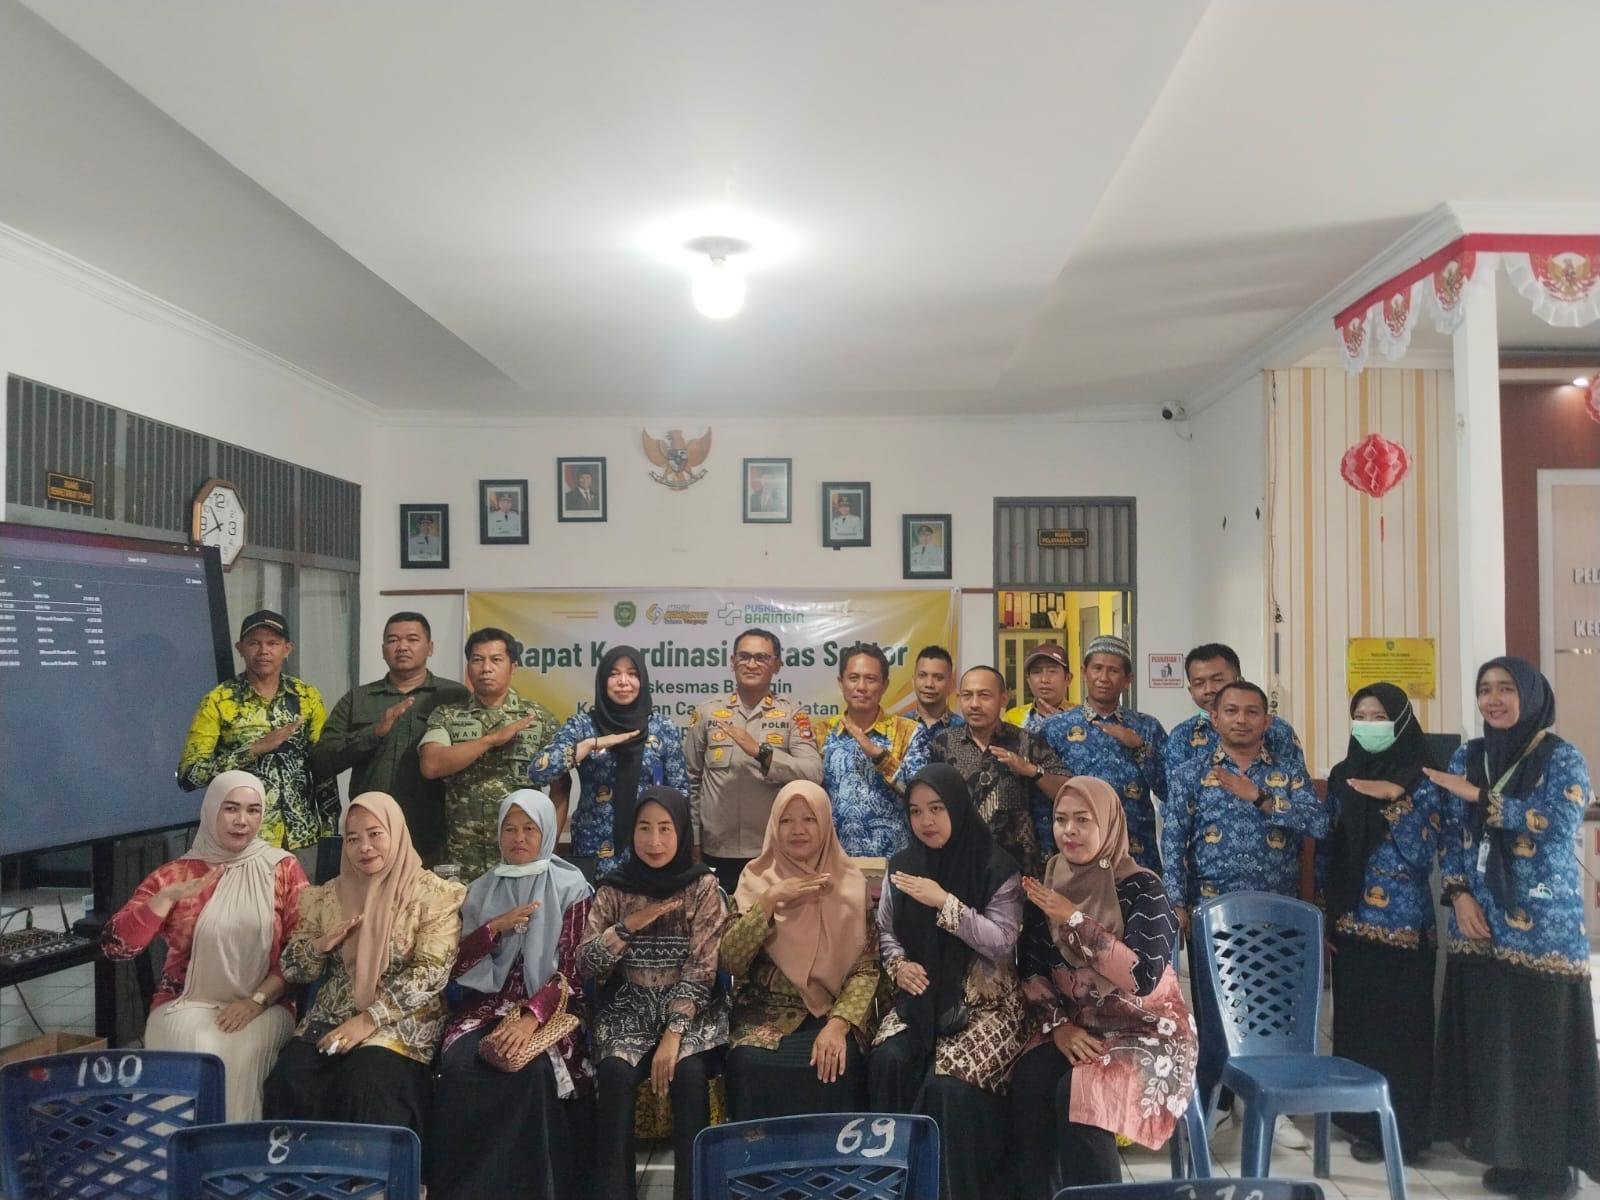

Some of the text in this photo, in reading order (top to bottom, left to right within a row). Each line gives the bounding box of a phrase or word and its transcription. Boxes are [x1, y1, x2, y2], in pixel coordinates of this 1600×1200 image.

[591, 640, 728, 668] Krdinasi
[77, 1054, 143, 1087] 100
[835, 1117, 897, 1158] 69
